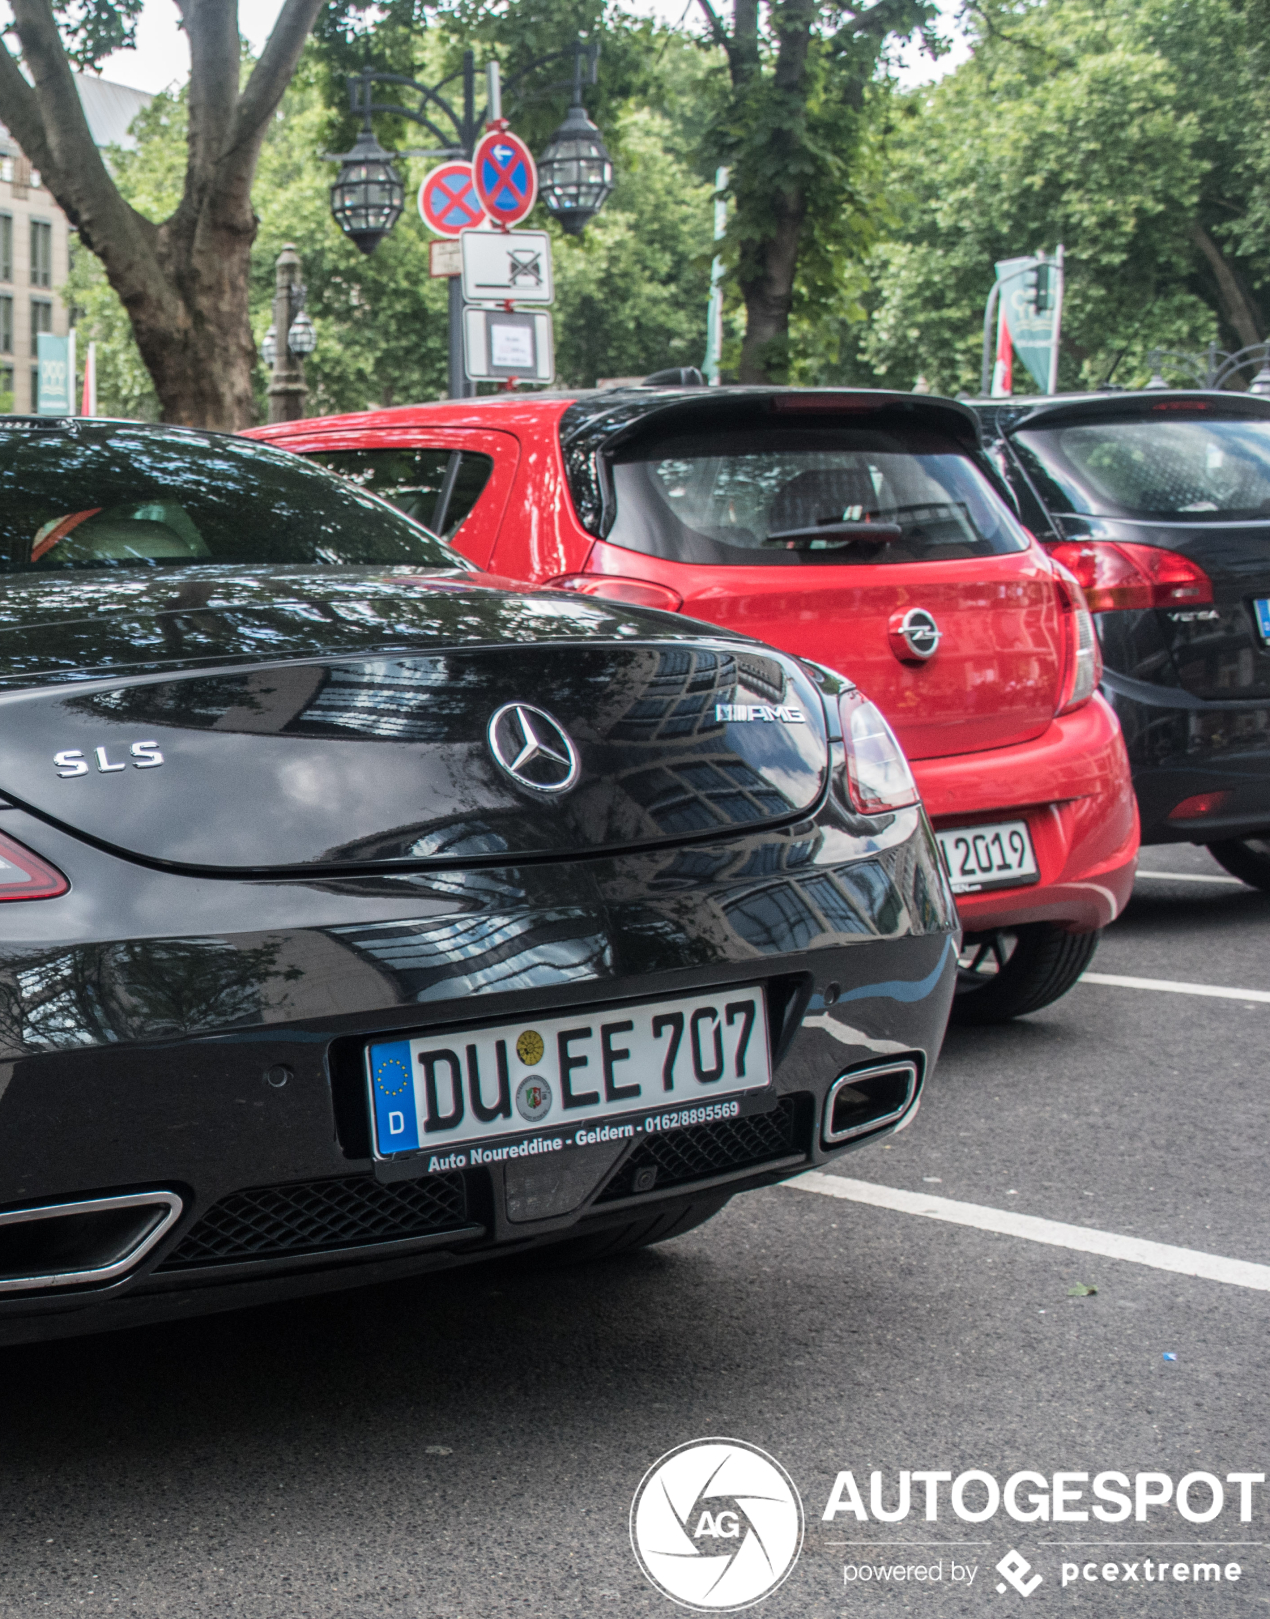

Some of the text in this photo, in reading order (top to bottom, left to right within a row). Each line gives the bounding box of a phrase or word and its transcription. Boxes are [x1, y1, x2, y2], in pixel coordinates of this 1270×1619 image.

[53, 741, 165, 779] SLS
[954, 828, 1026, 877] 2019
[418, 999, 756, 1134] DU EE 707
[388, 1111, 405, 1135] D
[428, 1152, 466, 1173] Auto
[470, 1136, 563, 1165] Noureddine
[575, 1123, 634, 1146] Geldern
[644, 1101, 740, 1133] 0162/8895569
